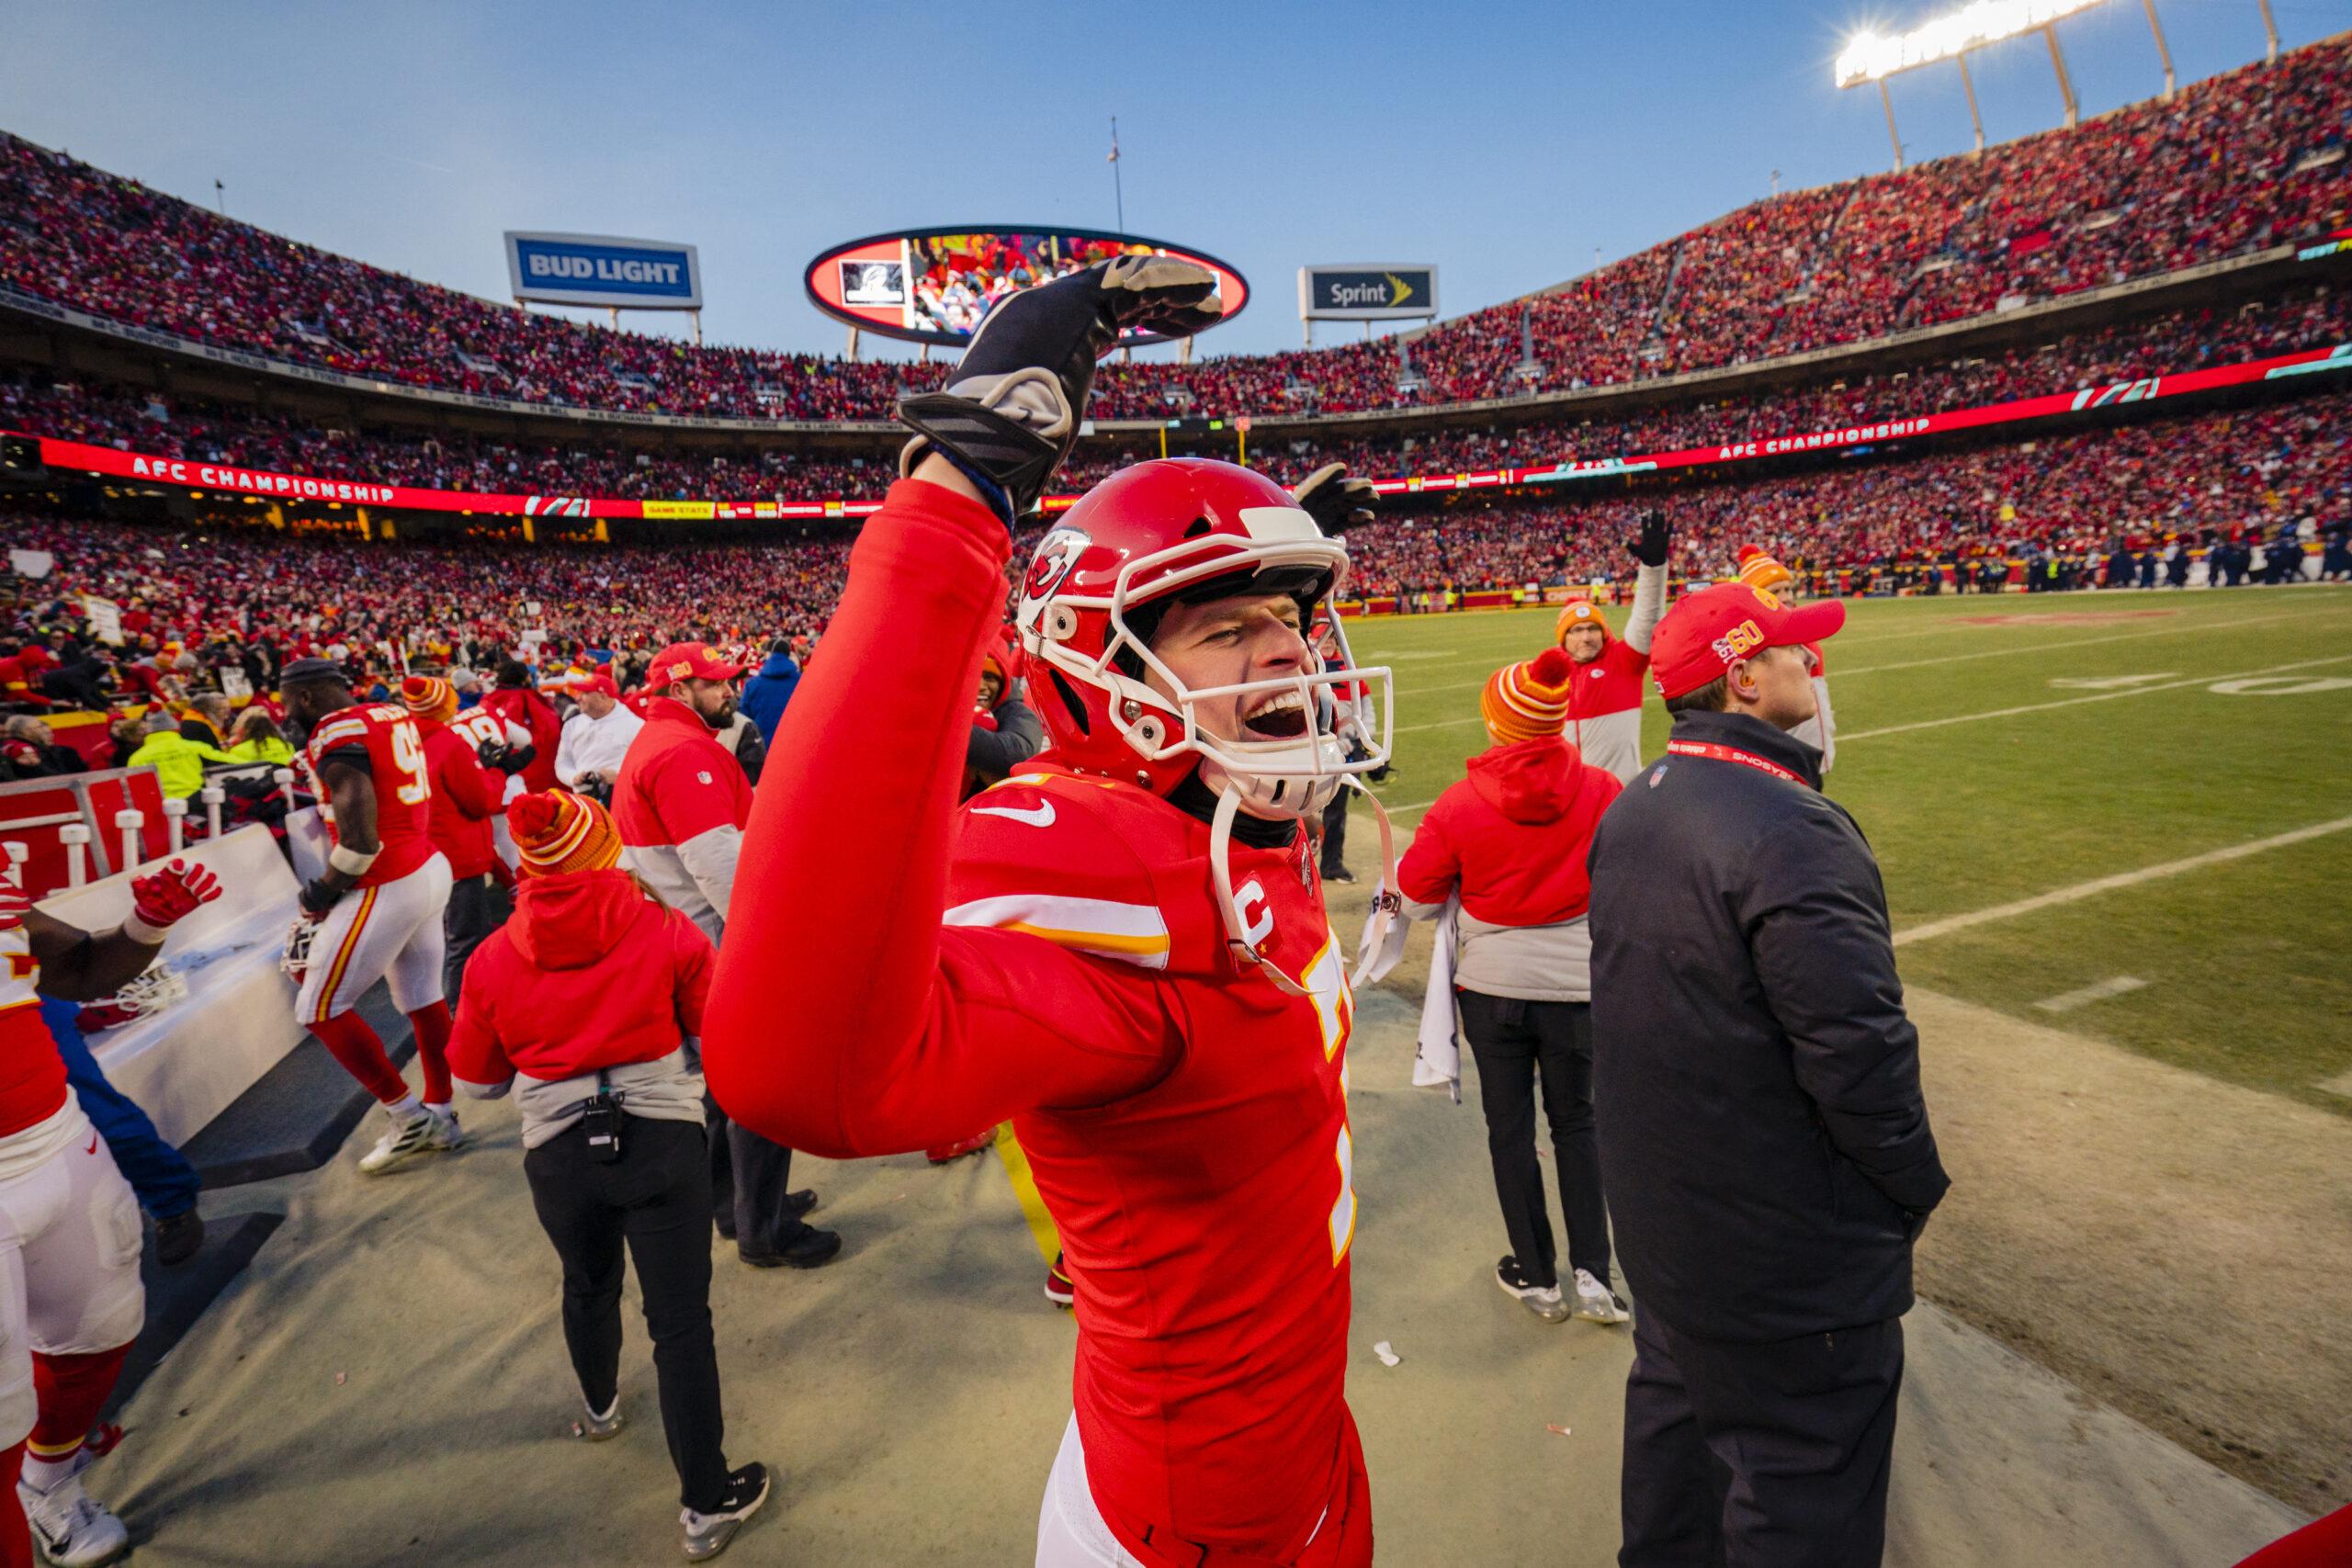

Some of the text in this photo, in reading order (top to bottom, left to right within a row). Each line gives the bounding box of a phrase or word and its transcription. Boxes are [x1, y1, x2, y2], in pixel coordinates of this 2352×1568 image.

[528, 254, 679, 284] BUD LIGHT
[1330, 282, 1387, 308] Sprint
[1719, 418, 1929, 459] AFC CHAMPIONSHIP
[133, 457, 393, 502] AFC CHAMPIONSHIP
[1725, 619, 1764, 655] 60
[390, 720, 432, 806] 9
[1233, 879, 1273, 947] C
